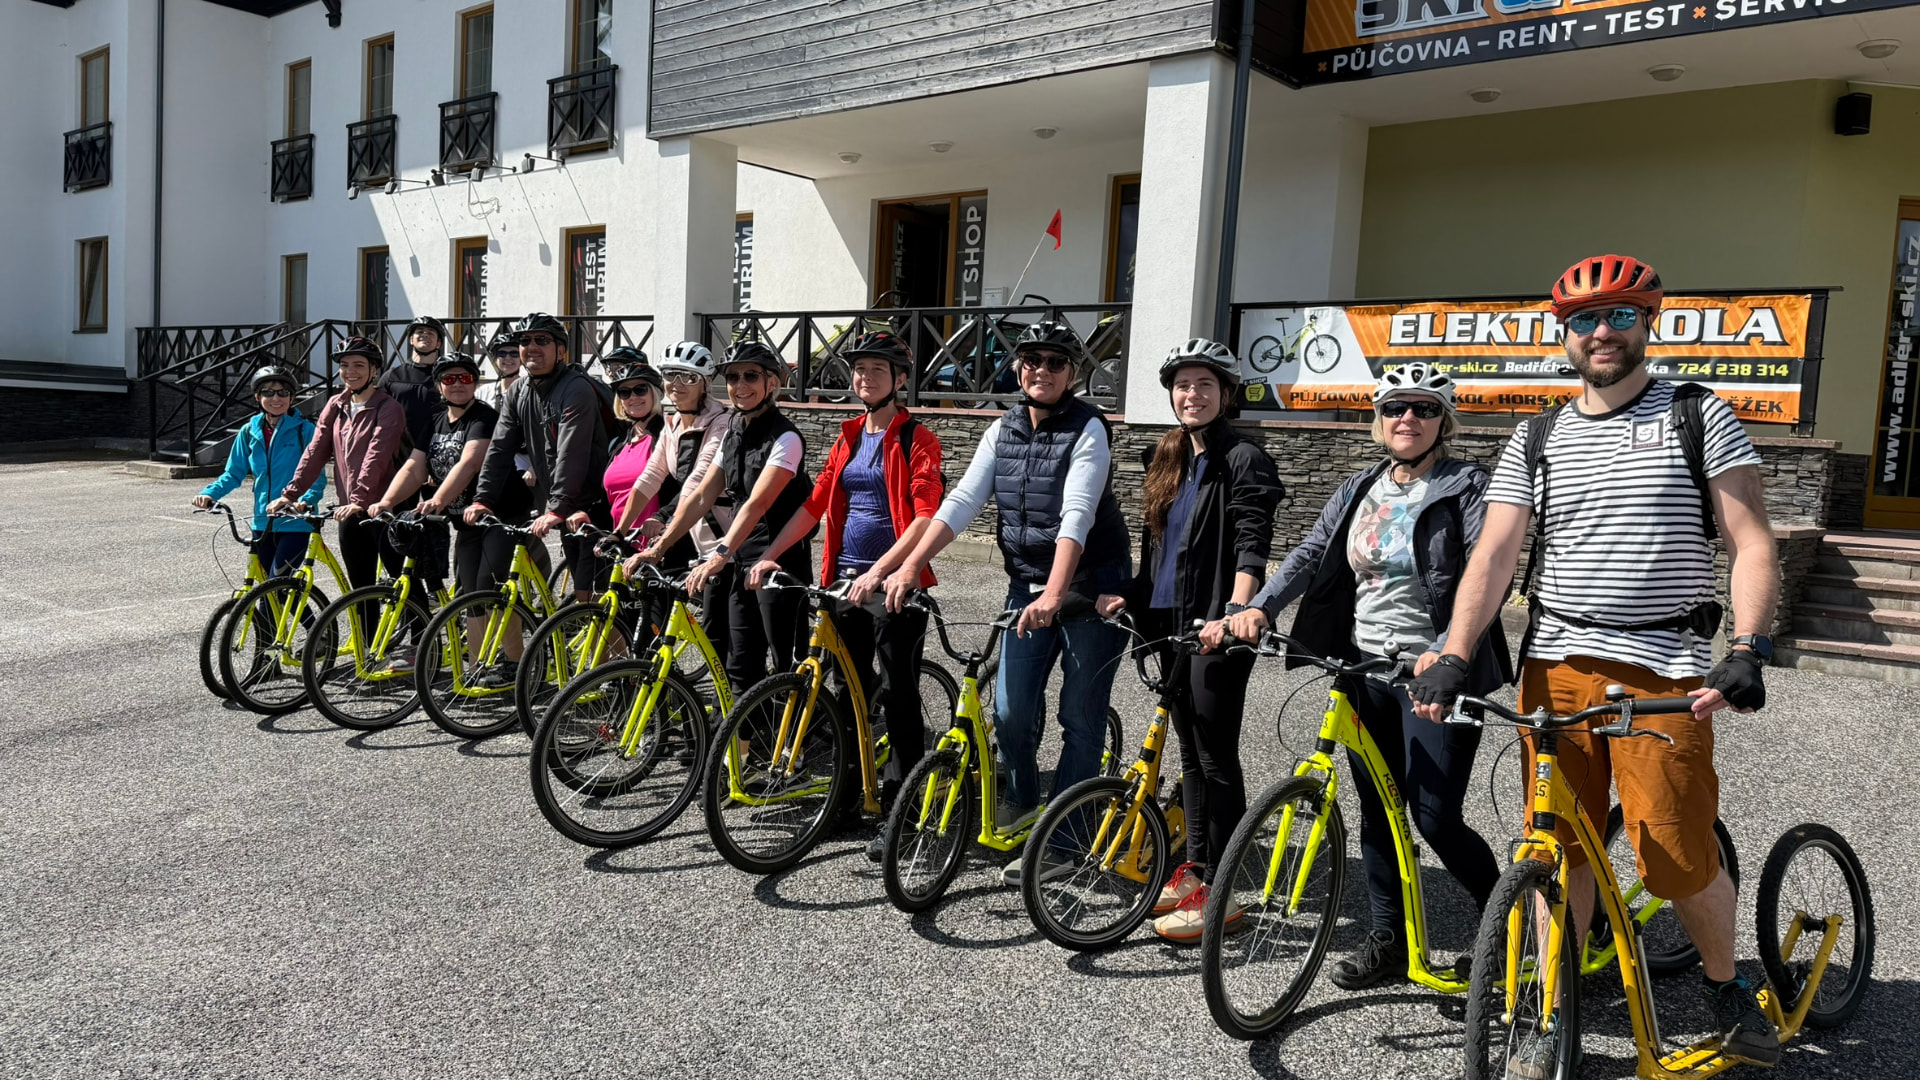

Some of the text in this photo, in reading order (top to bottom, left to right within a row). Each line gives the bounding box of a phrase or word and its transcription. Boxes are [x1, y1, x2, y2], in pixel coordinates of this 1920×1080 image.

[1332, 36, 1470, 73] PŮJČOVNA
[1498, 19, 1577, 50] RENT
[1605, 4, 1685, 35] TEST
[1715, 0, 1848, 20] SER
[585, 239, 597, 293] TEST
[963, 206, 982, 283] SHOP
[1677, 362, 1711, 376] 724
[1715, 363, 1752, 376] 238
[1756, 363, 1789, 377] 314
[1883, 235, 1920, 482] www.adler-ski.cz
